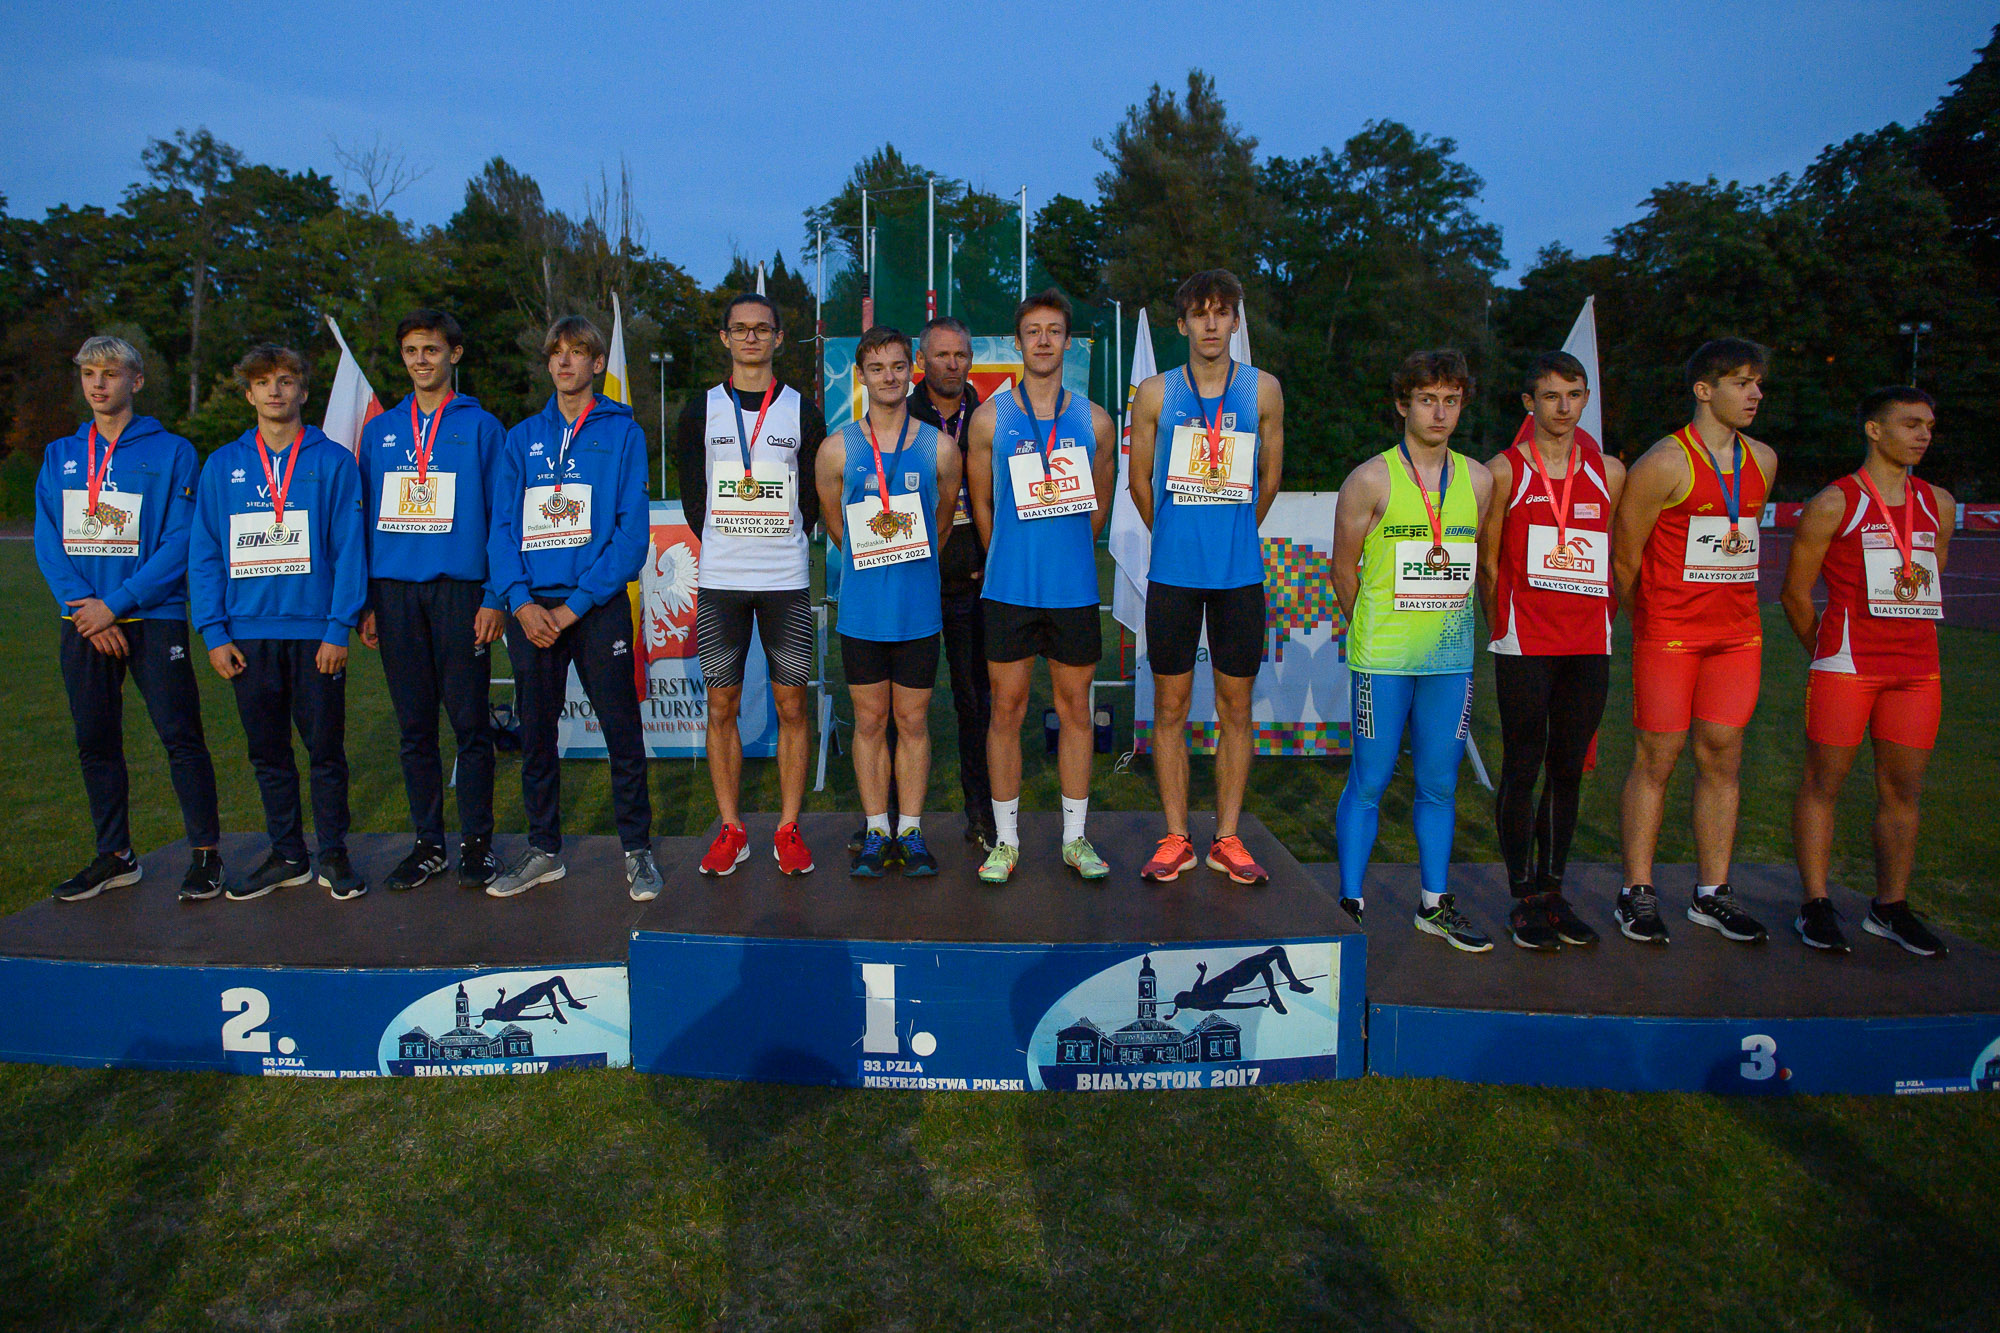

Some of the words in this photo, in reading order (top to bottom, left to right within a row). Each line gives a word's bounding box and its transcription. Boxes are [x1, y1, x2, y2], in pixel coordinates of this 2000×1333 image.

[1192, 462, 1228, 475] PZA
[1221, 489, 1243, 497] 2022
[1023, 506, 1069, 518] BIAŁYSTOK
[1072, 502, 1093, 511] 2022
[382, 523, 426, 531] BIAŁYSTOK
[526, 538, 566, 548] BIAŁYSTOK
[568, 537, 587, 545] 2022
[856, 540, 885, 548] Podlaskie
[67, 545, 108, 554] BIAŁYSTOK
[111, 546, 134, 554] 2022
[858, 553, 903, 567] BIAŁYSTOK
[905, 549, 926, 558] 2022
[235, 566, 282, 576] BIAŁYSTOK
[284, 564, 306, 573] 2022
[1689, 572, 1737, 580] BIAŁYSTOK
[1533, 580, 1580, 591] BIAŁYSTOK
[1583, 585, 1604, 594] 2022
[1874, 606, 1920, 615] BIAŁYSTOK
[1922, 608, 1938, 616] 2022
[862, 964, 936, 1057] 1.
[221, 987, 296, 1055] 2.
[1740, 1034, 1792, 1080] 3.
[414, 1063, 506, 1077] BIAŁYSTOK
[511, 1061, 549, 1075] 2017
[863, 1076, 968, 1090] MISTRZOSTWA
[973, 1078, 1024, 1091] POLSKI
[1077, 1071, 1203, 1091] BIAŁYSTOK
[1211, 1067, 1261, 1087] 2017
